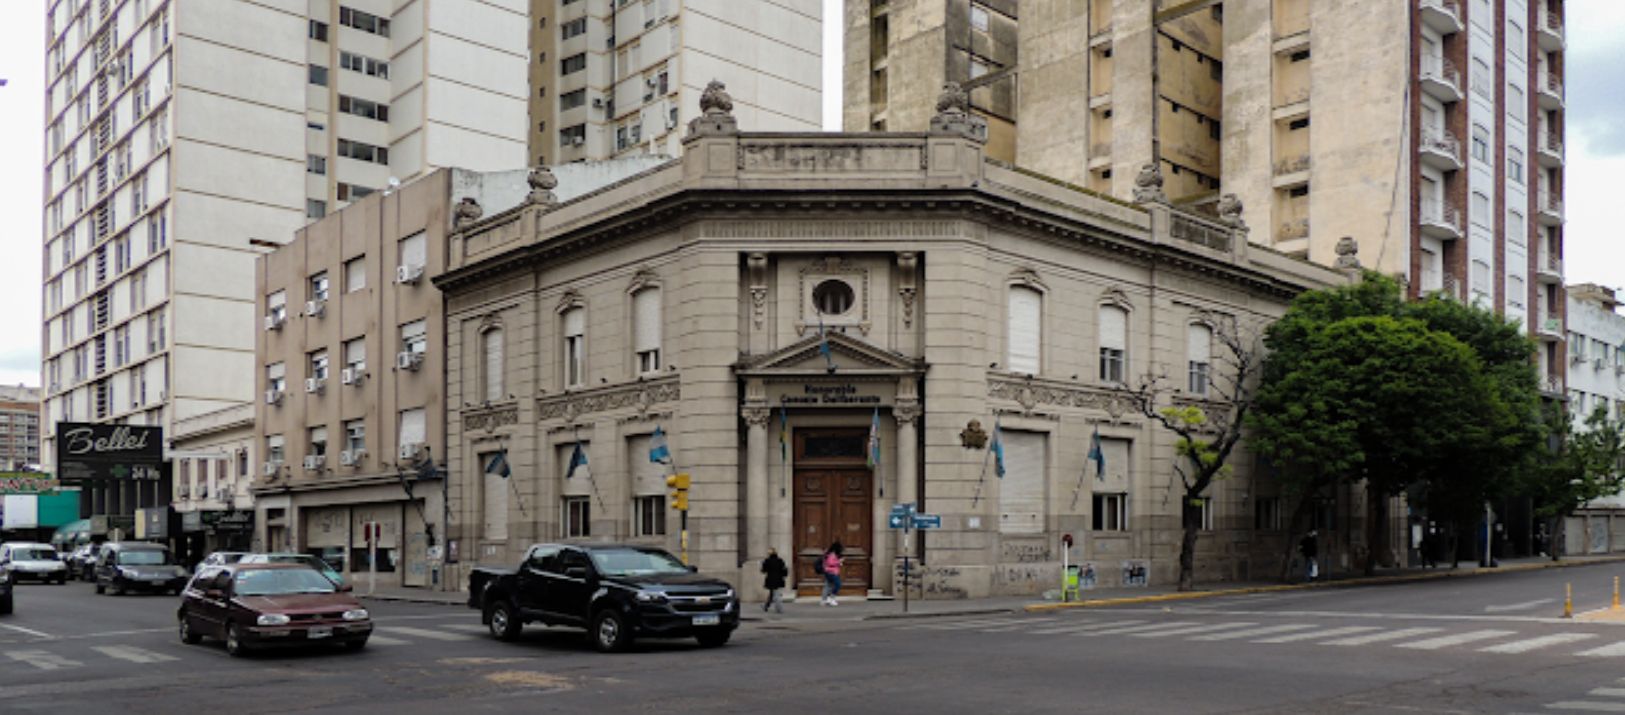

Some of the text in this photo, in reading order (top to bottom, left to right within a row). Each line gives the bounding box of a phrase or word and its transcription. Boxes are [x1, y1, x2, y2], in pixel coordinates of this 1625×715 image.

[804, 383, 856, 394] Honorable
[822, 394, 881, 403] Deliberante
[132, 464, 145, 480] 24
